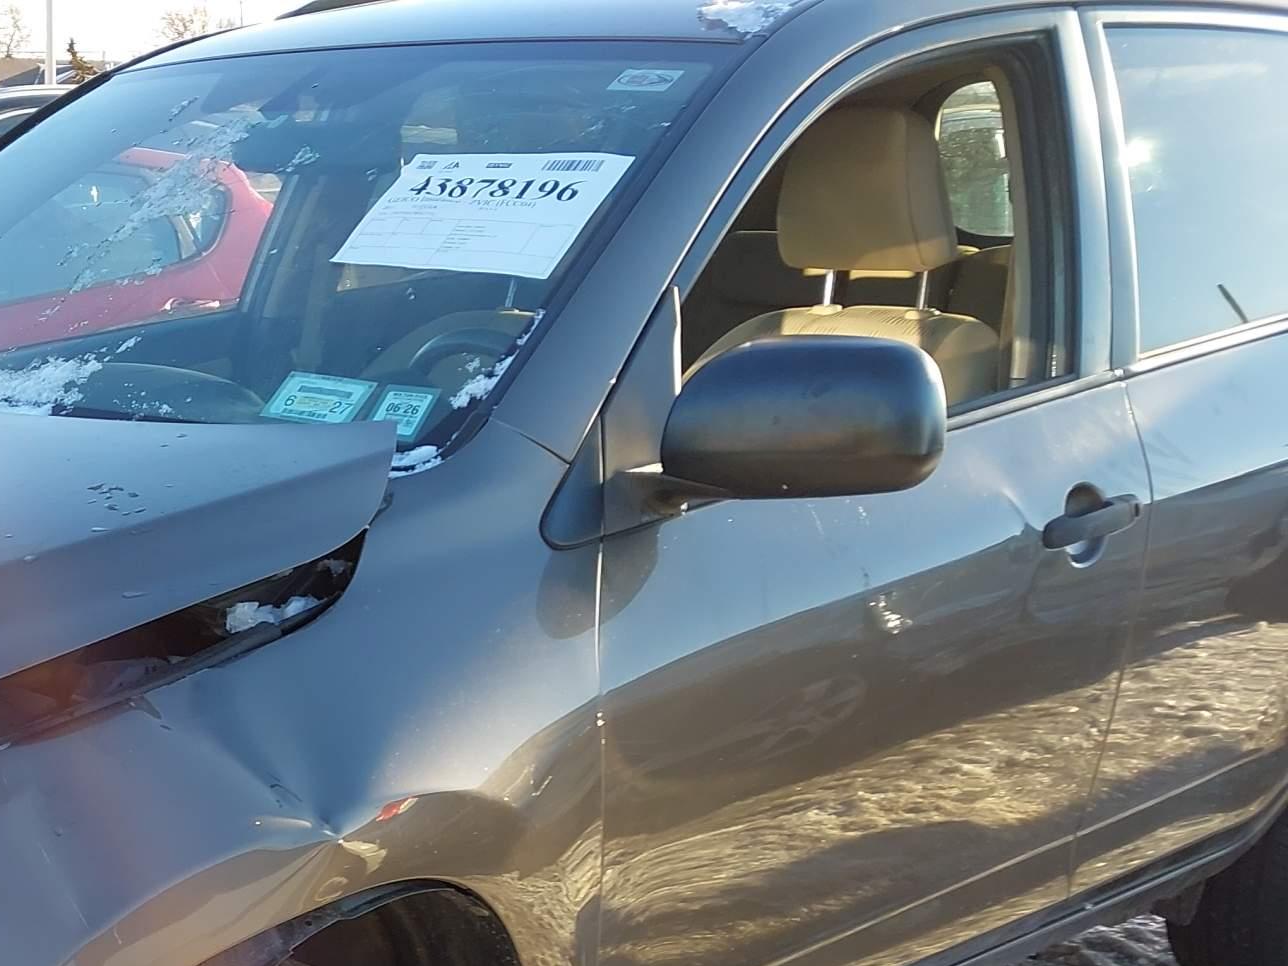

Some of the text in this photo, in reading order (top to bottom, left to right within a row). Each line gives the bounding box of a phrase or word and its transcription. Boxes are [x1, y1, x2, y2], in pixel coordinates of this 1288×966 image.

[409, 175, 587, 201] 43878196
[284, 394, 297, 407] 6
[328, 400, 355, 415] 27
[385, 402, 421, 415] 06 26
